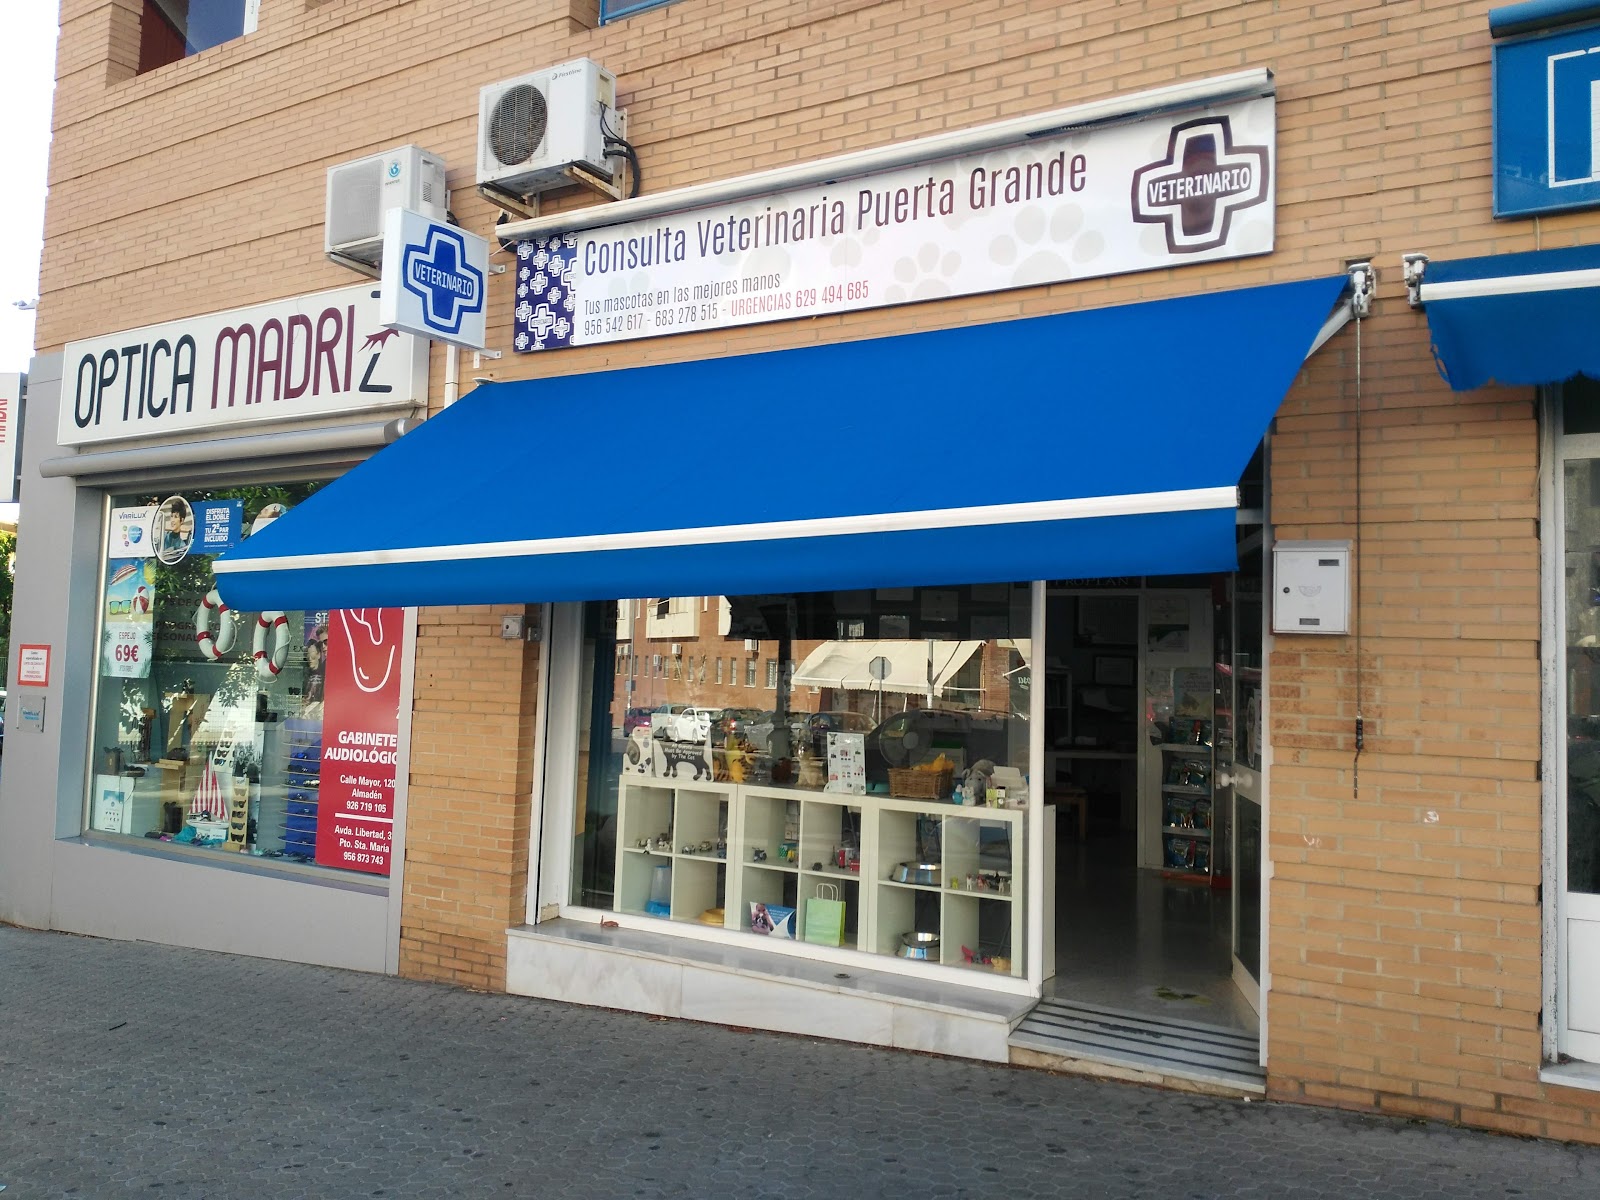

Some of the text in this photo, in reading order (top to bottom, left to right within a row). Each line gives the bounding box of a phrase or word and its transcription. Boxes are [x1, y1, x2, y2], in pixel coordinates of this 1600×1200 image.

[1149, 167, 1250, 203] VETERINARIO
[584, 151, 1087, 276] Consulta Veterinaria Puerta Grande
[414, 262, 473, 297] VETERINARIO
[585, 273, 781, 316] Tus mascotas en las mejores manos
[584, 318, 602, 336] 956
[605, 316, 623, 334] 542
[627, 313, 644, 331] 617
[655, 309, 674, 327] 683
[678, 305, 697, 324] 278
[700, 303, 718, 321] 515
[731, 292, 792, 317] URGENCIAS
[795, 288, 817, 308] 629
[821, 284, 843, 304] 494
[847, 280, 869, 301] 685
[74, 334, 196, 428] OPTICA
[118, 631, 136, 640] ESPEJO
[115, 644, 139, 662] 69€
[338, 731, 397, 747] GABINETE
[340, 774, 357, 785] Calle
[358, 776, 382, 788] Mayor,
[352, 788, 382, 800] Almadén
[346, 800, 387, 814] 926 719 105
[334, 825, 354, 836] Avda.
[355, 827, 386, 840] Libertad,
[339, 838, 390, 854] Pto. Sta. María
[343, 851, 384, 866] 956 873 743
